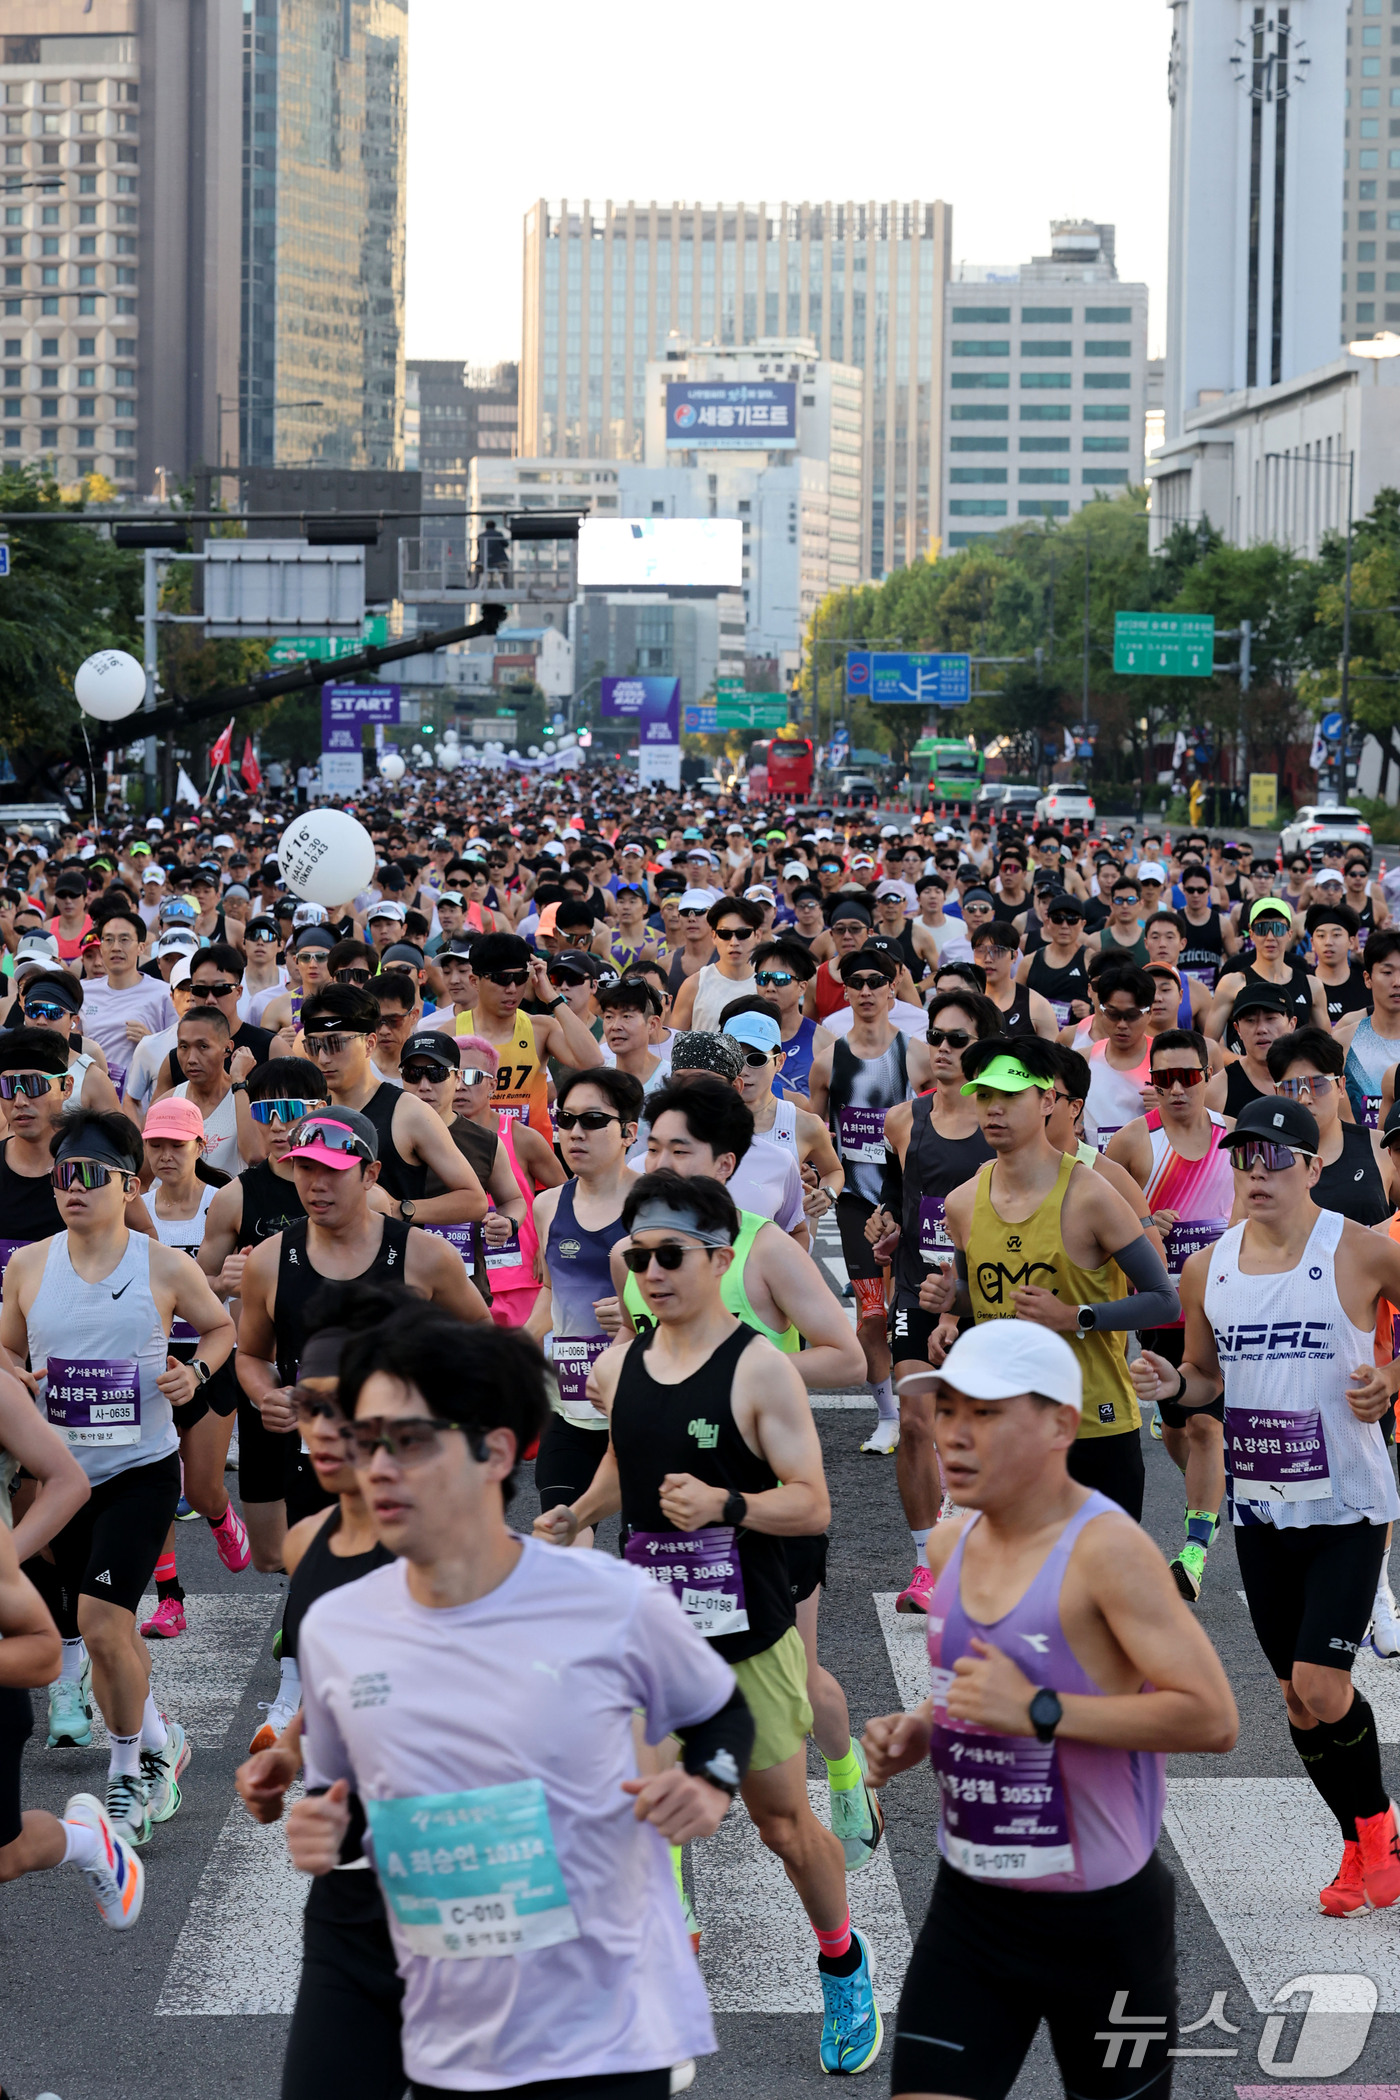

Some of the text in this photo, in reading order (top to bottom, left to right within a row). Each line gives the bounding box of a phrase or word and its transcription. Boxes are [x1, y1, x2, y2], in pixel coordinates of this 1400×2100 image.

[697, 404, 789, 427] 세종기프트
[331, 697, 394, 711] START
[291, 858, 305, 882] HALF
[298, 864, 314, 887] 10km
[1007, 1068, 1029, 1079] 2XU
[842, 1121, 850, 1132] A
[864, 1145, 885, 1156] 나-027
[922, 1218, 931, 1231] A
[1182, 1225, 1212, 1235] 서울특별시
[446, 1231, 472, 1241] 30801
[922, 1236, 937, 1245] Hal
[557, 1346, 585, 1356] 사-0066
[1240, 1353, 1265, 1361] PACE
[1265, 1351, 1306, 1360] RUNNING
[1307, 1351, 1336, 1360] CREW
[76, 1367, 113, 1378] 서울특별시
[559, 1362, 569, 1376] A
[48, 1384, 135, 1402] A 최경국 31015
[562, 1384, 578, 1393] Half
[50, 1407, 67, 1419] Half
[95, 1407, 131, 1420] 사-0635
[1258, 1418, 1295, 1429] 서울특별시
[79, 1431, 114, 1441] 동아일보
[1232, 1436, 1320, 1455] A 강성진 31100
[1234, 1460, 1255, 1472] Half
[1303, 1464, 1324, 1473] RACE
[659, 1538, 704, 1553] 서울특별시
[692, 1563, 735, 1580] 30485
[688, 1594, 732, 1613] 나-0198
[1000, 1786, 1053, 1804] 30517
[388, 1851, 409, 1878] A
